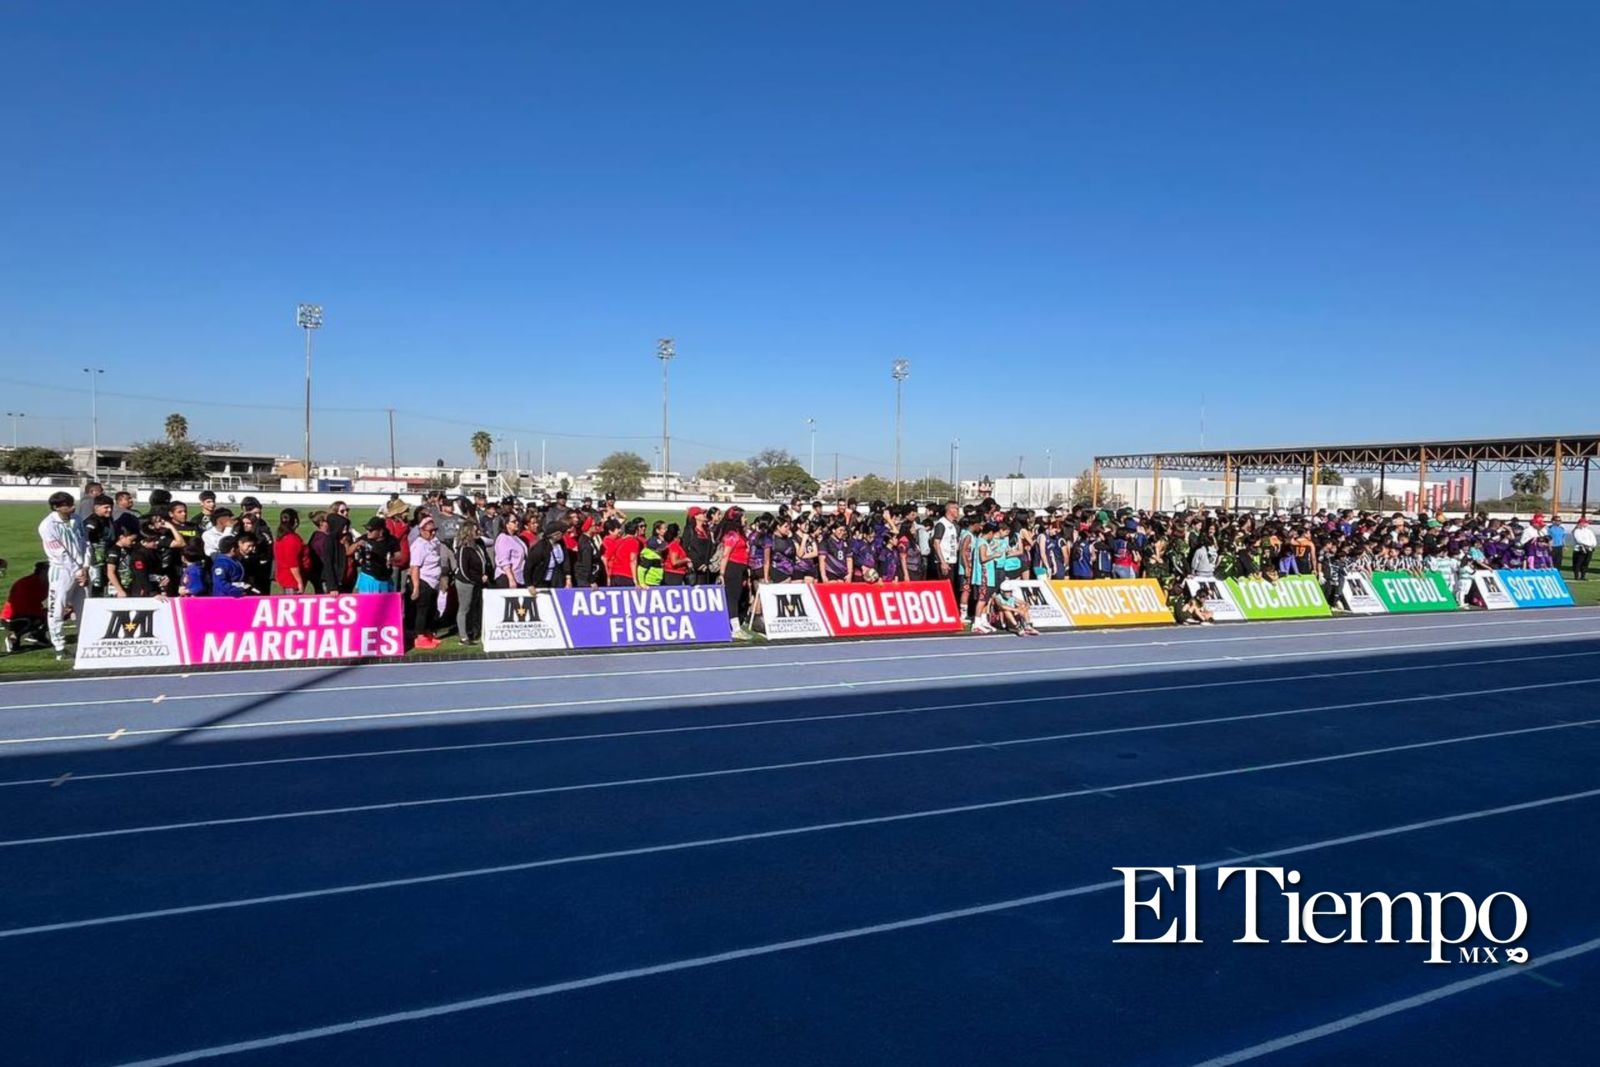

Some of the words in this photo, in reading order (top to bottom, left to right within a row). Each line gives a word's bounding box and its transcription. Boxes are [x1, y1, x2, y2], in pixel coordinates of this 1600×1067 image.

[572, 586, 724, 617] ACTIVACIÓN
[1060, 584, 1169, 619] BASQUETBOL
[1237, 580, 1324, 609] TOCHITO
[1510, 576, 1569, 602] SOFTBOL
[252, 596, 358, 628] ARTES
[829, 590, 956, 629] VOLEIBOL
[610, 611, 696, 643] FÍSICA
[80, 645, 170, 658] MONCLOVA
[202, 626, 399, 662] MARCIALES
